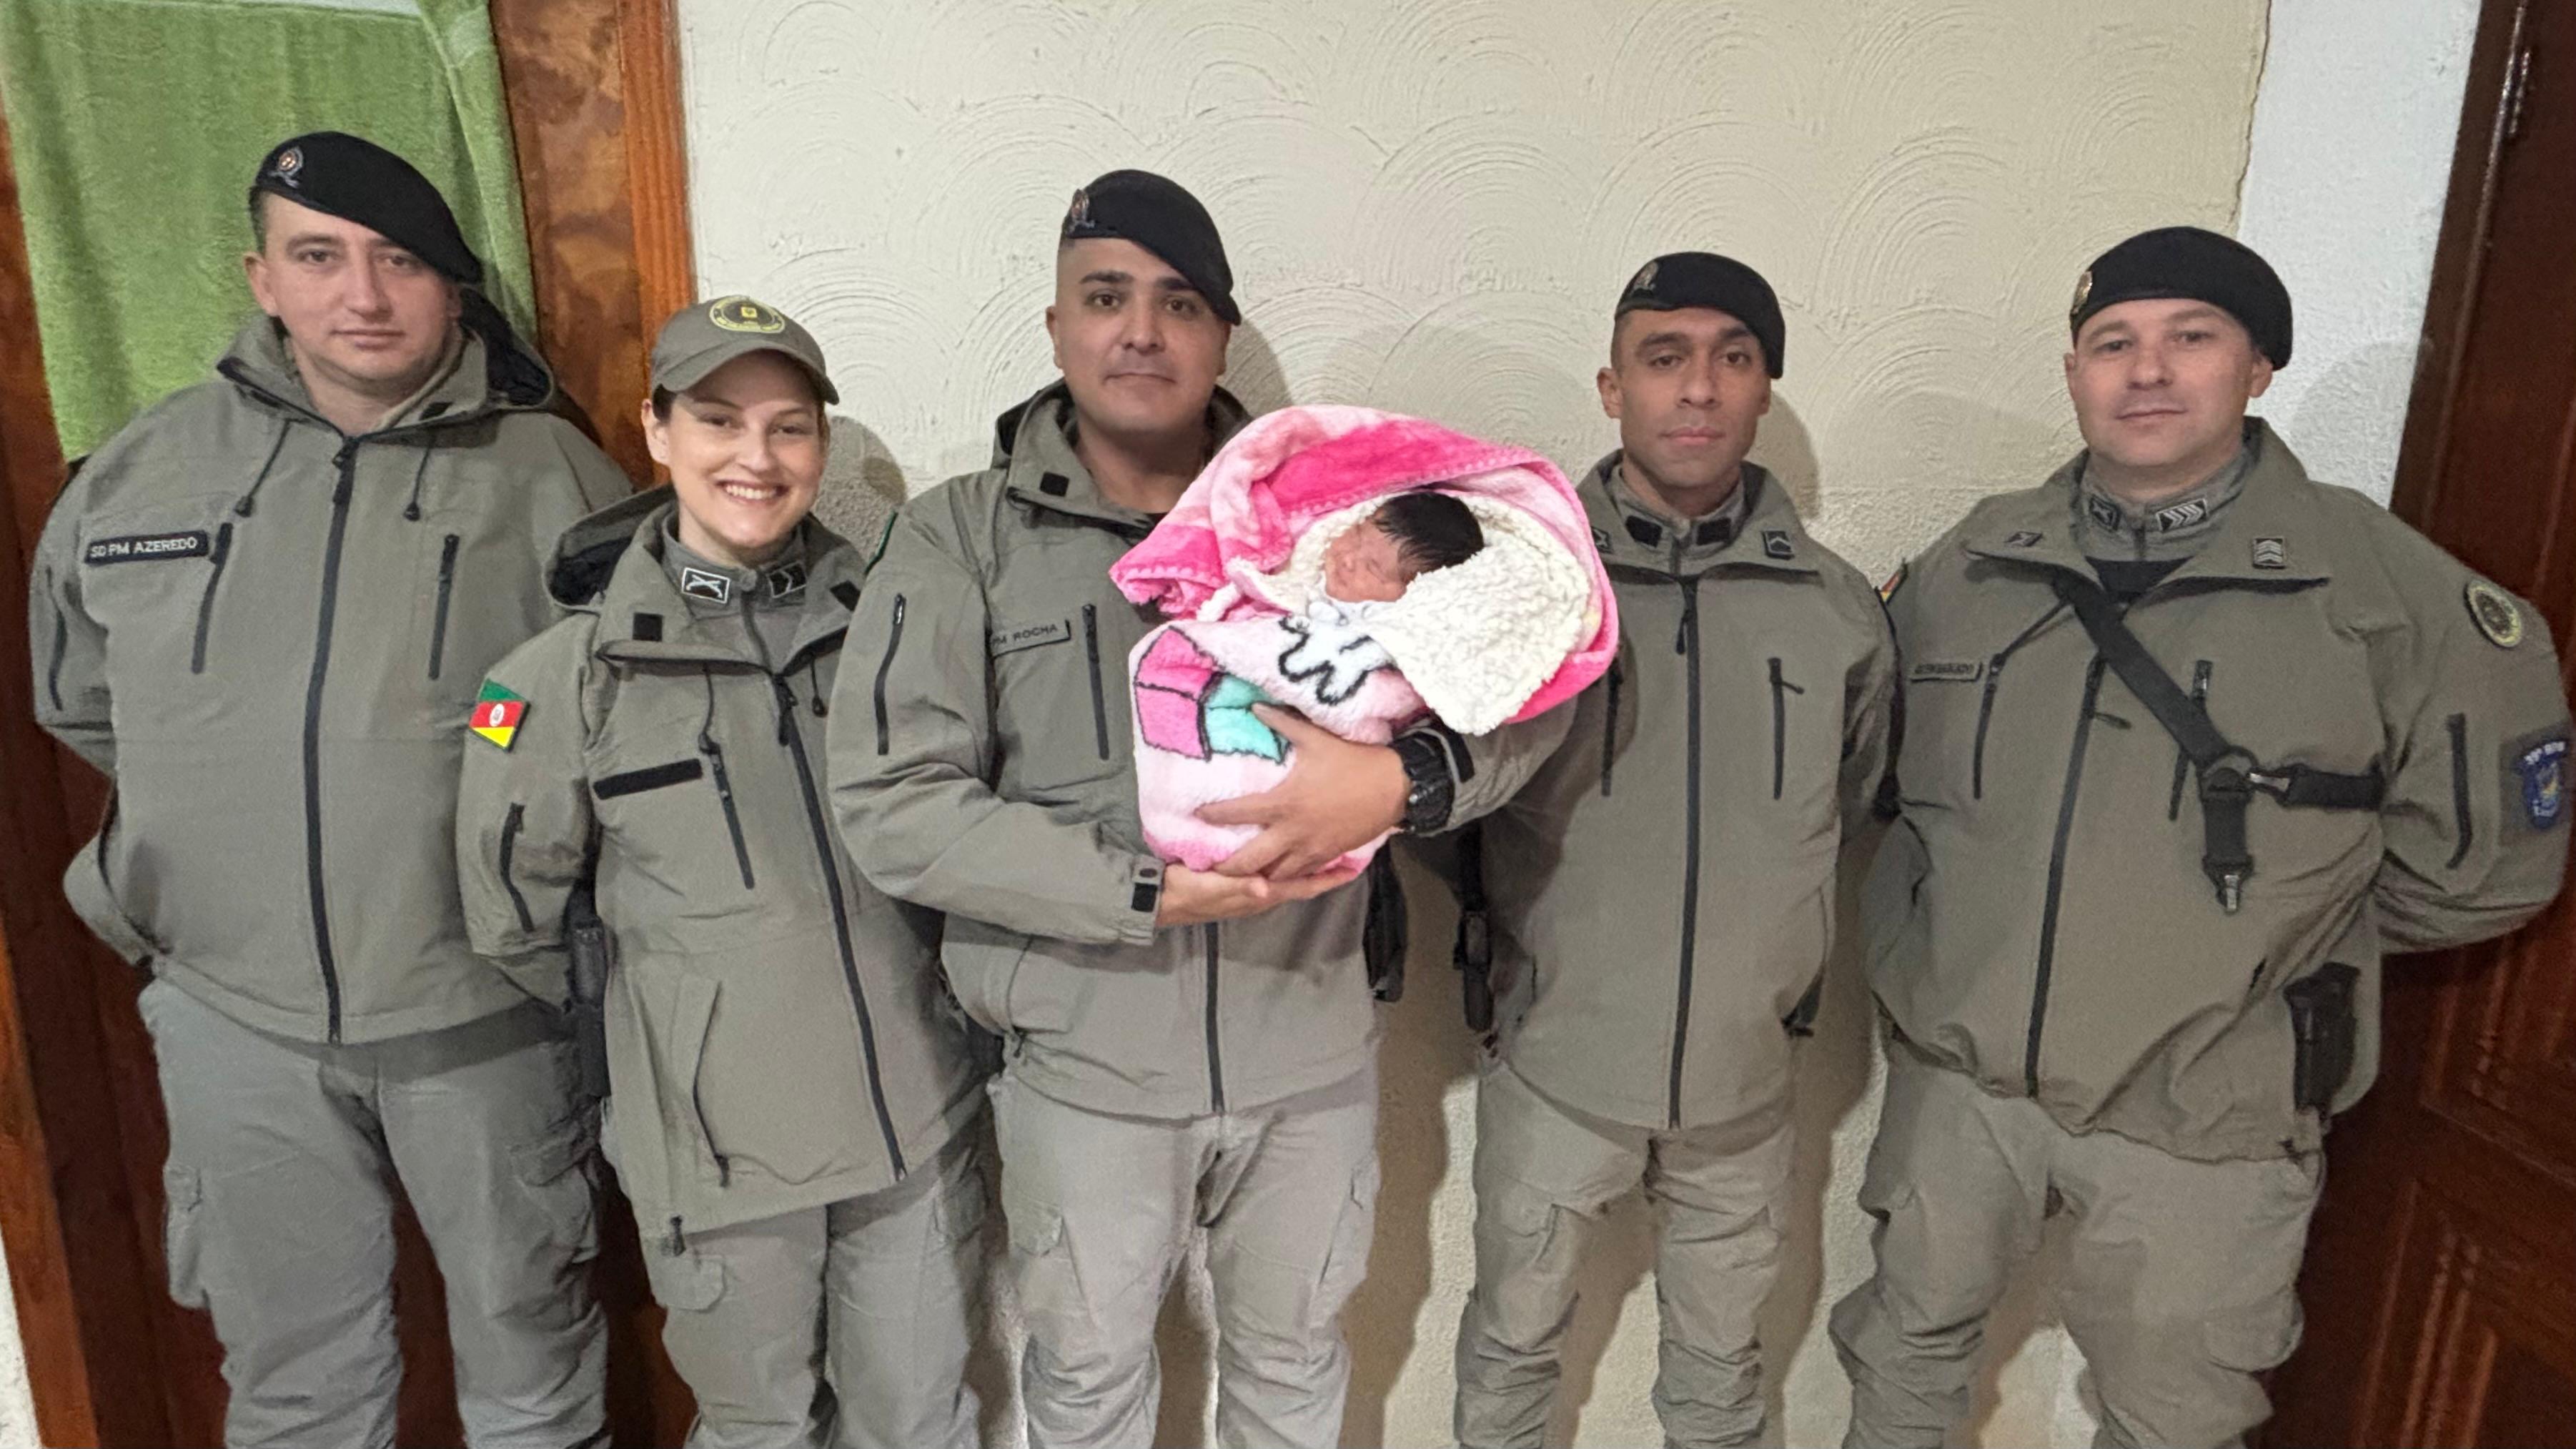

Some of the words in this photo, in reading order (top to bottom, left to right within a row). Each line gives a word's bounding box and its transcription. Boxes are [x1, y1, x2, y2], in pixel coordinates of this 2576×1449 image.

[90, 545, 106, 558] SD
[109, 543, 130, 555] PM
[134, 537, 197, 553] AZEREDO
[1014, 624, 1058, 641] ROCHA
